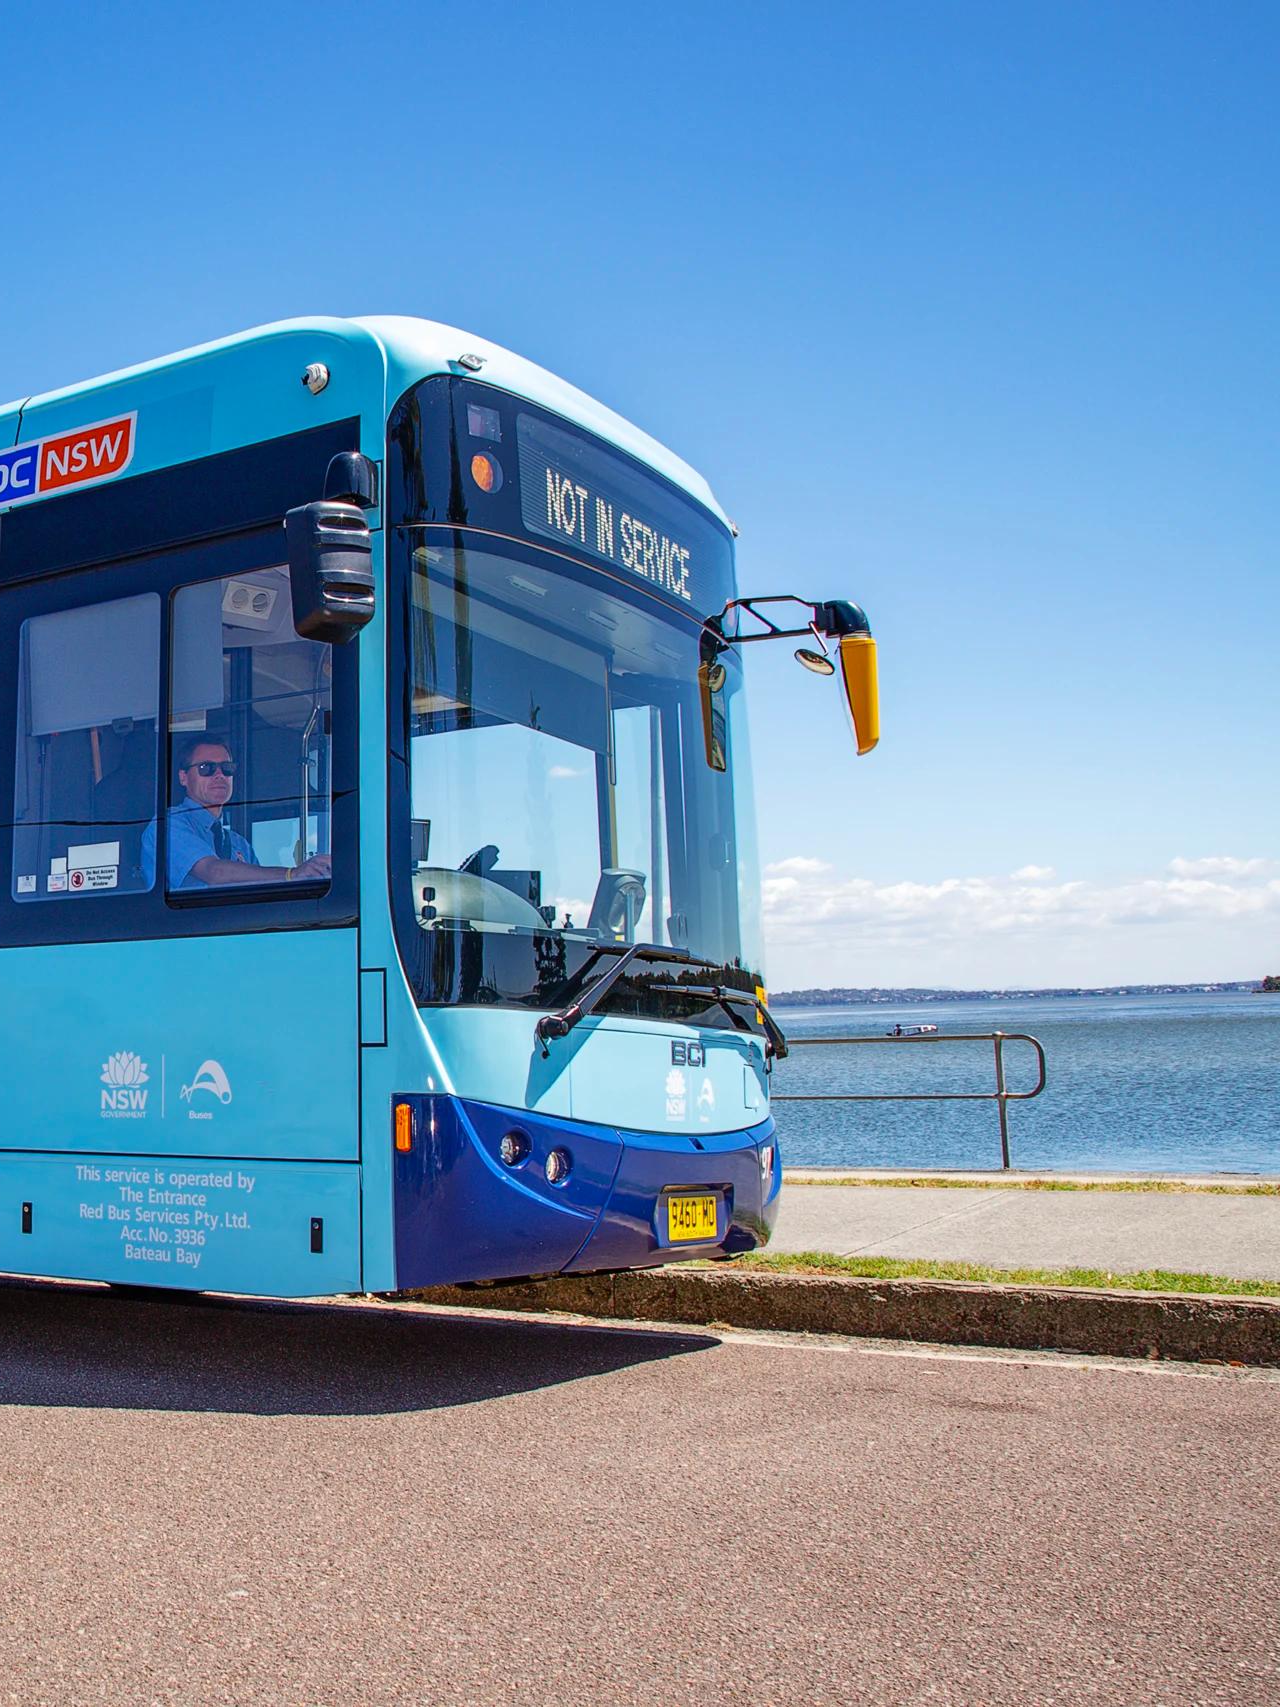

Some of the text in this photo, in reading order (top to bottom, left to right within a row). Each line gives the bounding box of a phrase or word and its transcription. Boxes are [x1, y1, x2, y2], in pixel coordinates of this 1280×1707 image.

[45, 431, 124, 480] NSW
[546, 467, 692, 601] NOT IN SERVICE
[671, 1040, 706, 1067] BCI
[101, 1089, 148, 1110] NSW
[188, 1110, 213, 1119] Buses
[75, 1165, 255, 1192] This service is operated by
[119, 1187, 207, 1206] The Entrance
[79, 1203, 103, 1219] Red
[108, 1205, 130, 1221] Bus
[135, 1206, 190, 1225] Services
[125, 1244, 201, 1268] Bateau Bay
